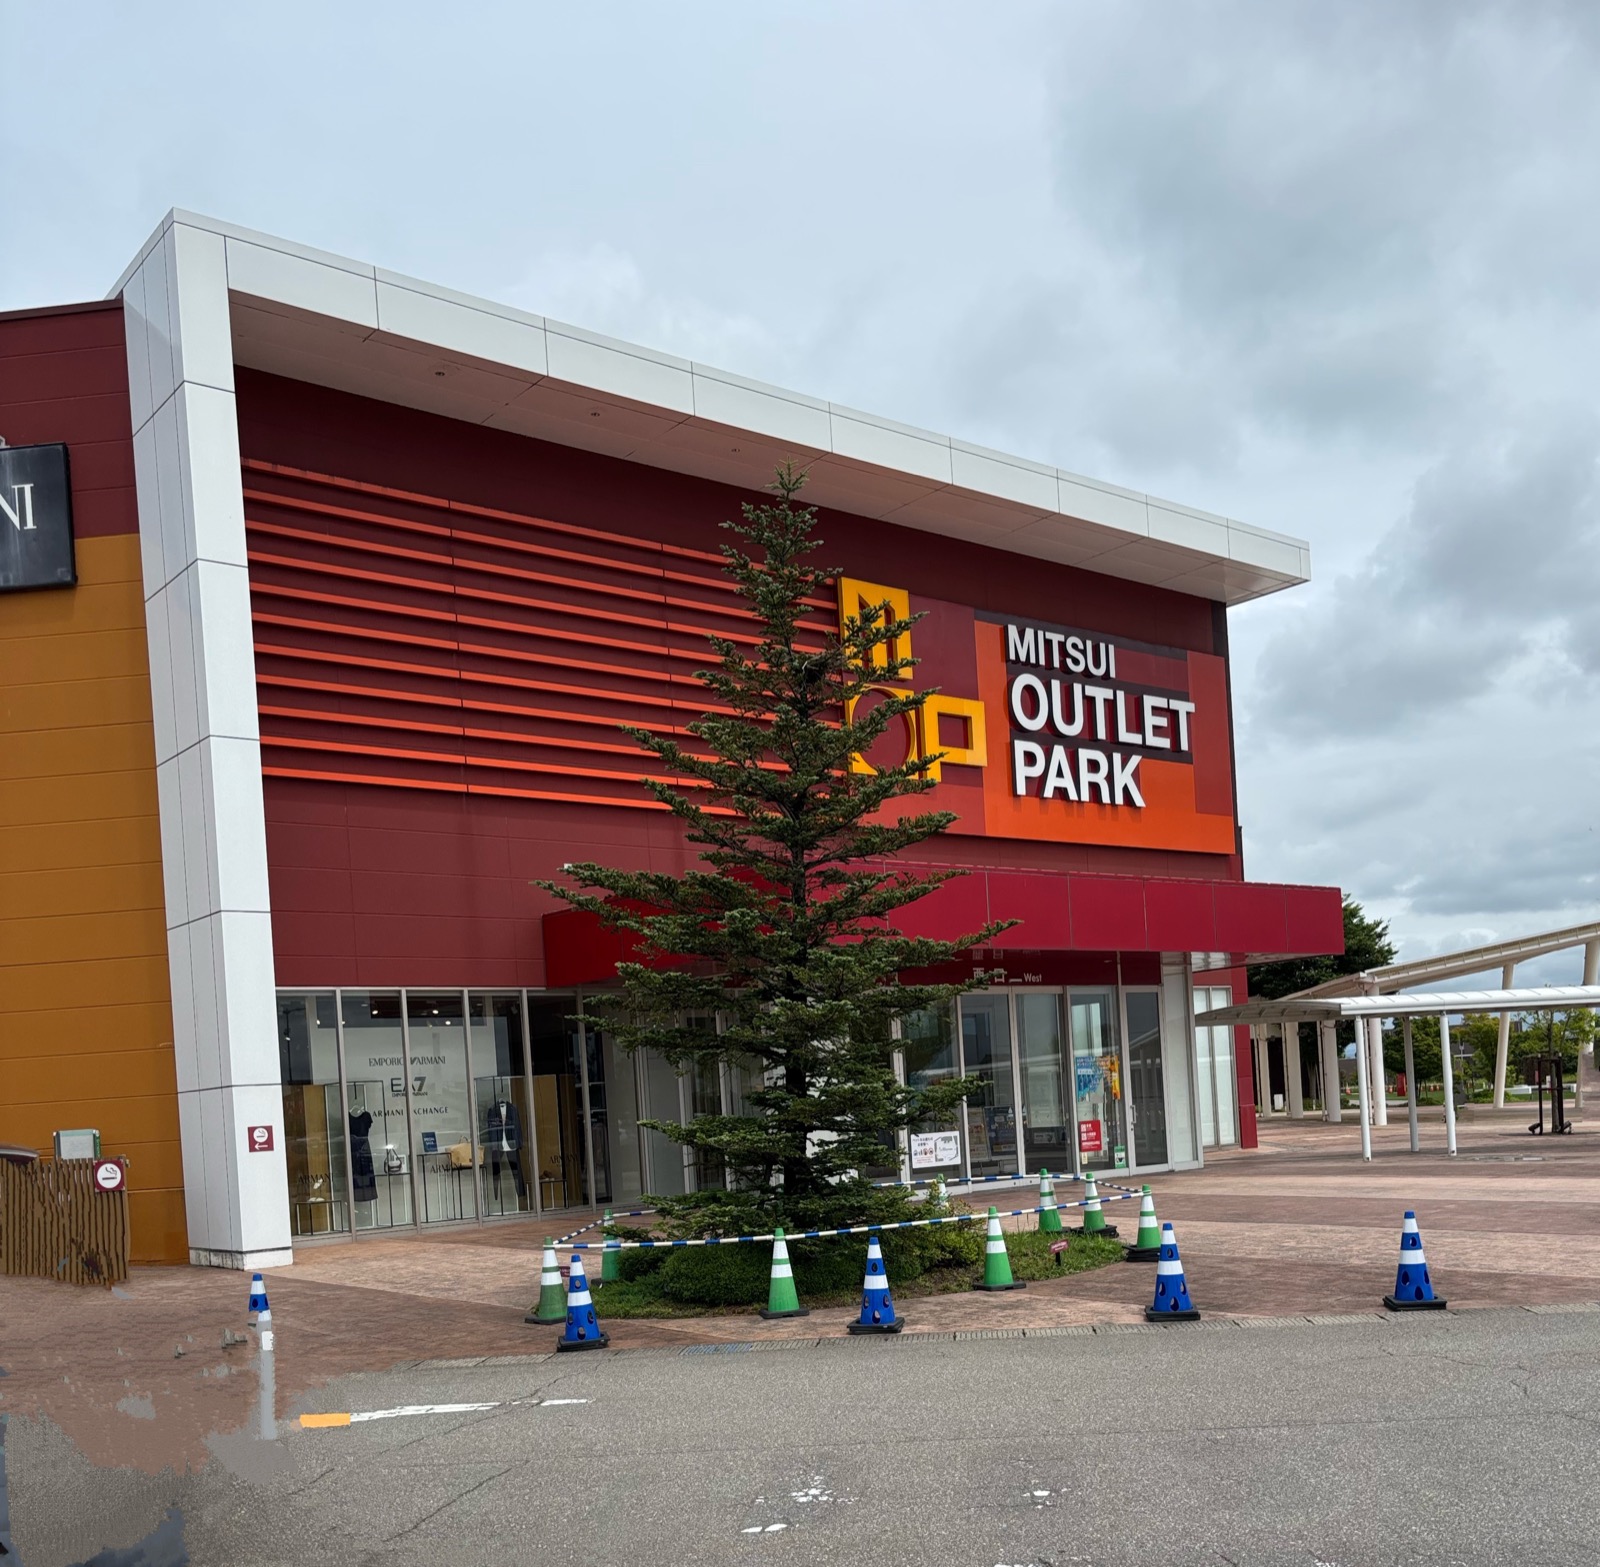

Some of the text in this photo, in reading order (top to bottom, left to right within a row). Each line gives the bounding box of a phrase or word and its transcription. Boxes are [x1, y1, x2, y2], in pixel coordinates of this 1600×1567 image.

[1006, 624, 1116, 679] MITSUI
[1010, 673, 1196, 752] OUTLET
[1013, 739, 1147, 809] PARK
[1023, 972, 1043, 983] West
[415, 1055, 446, 1065] ARMANI
[413, 1106, 449, 1116] XCHANGE
